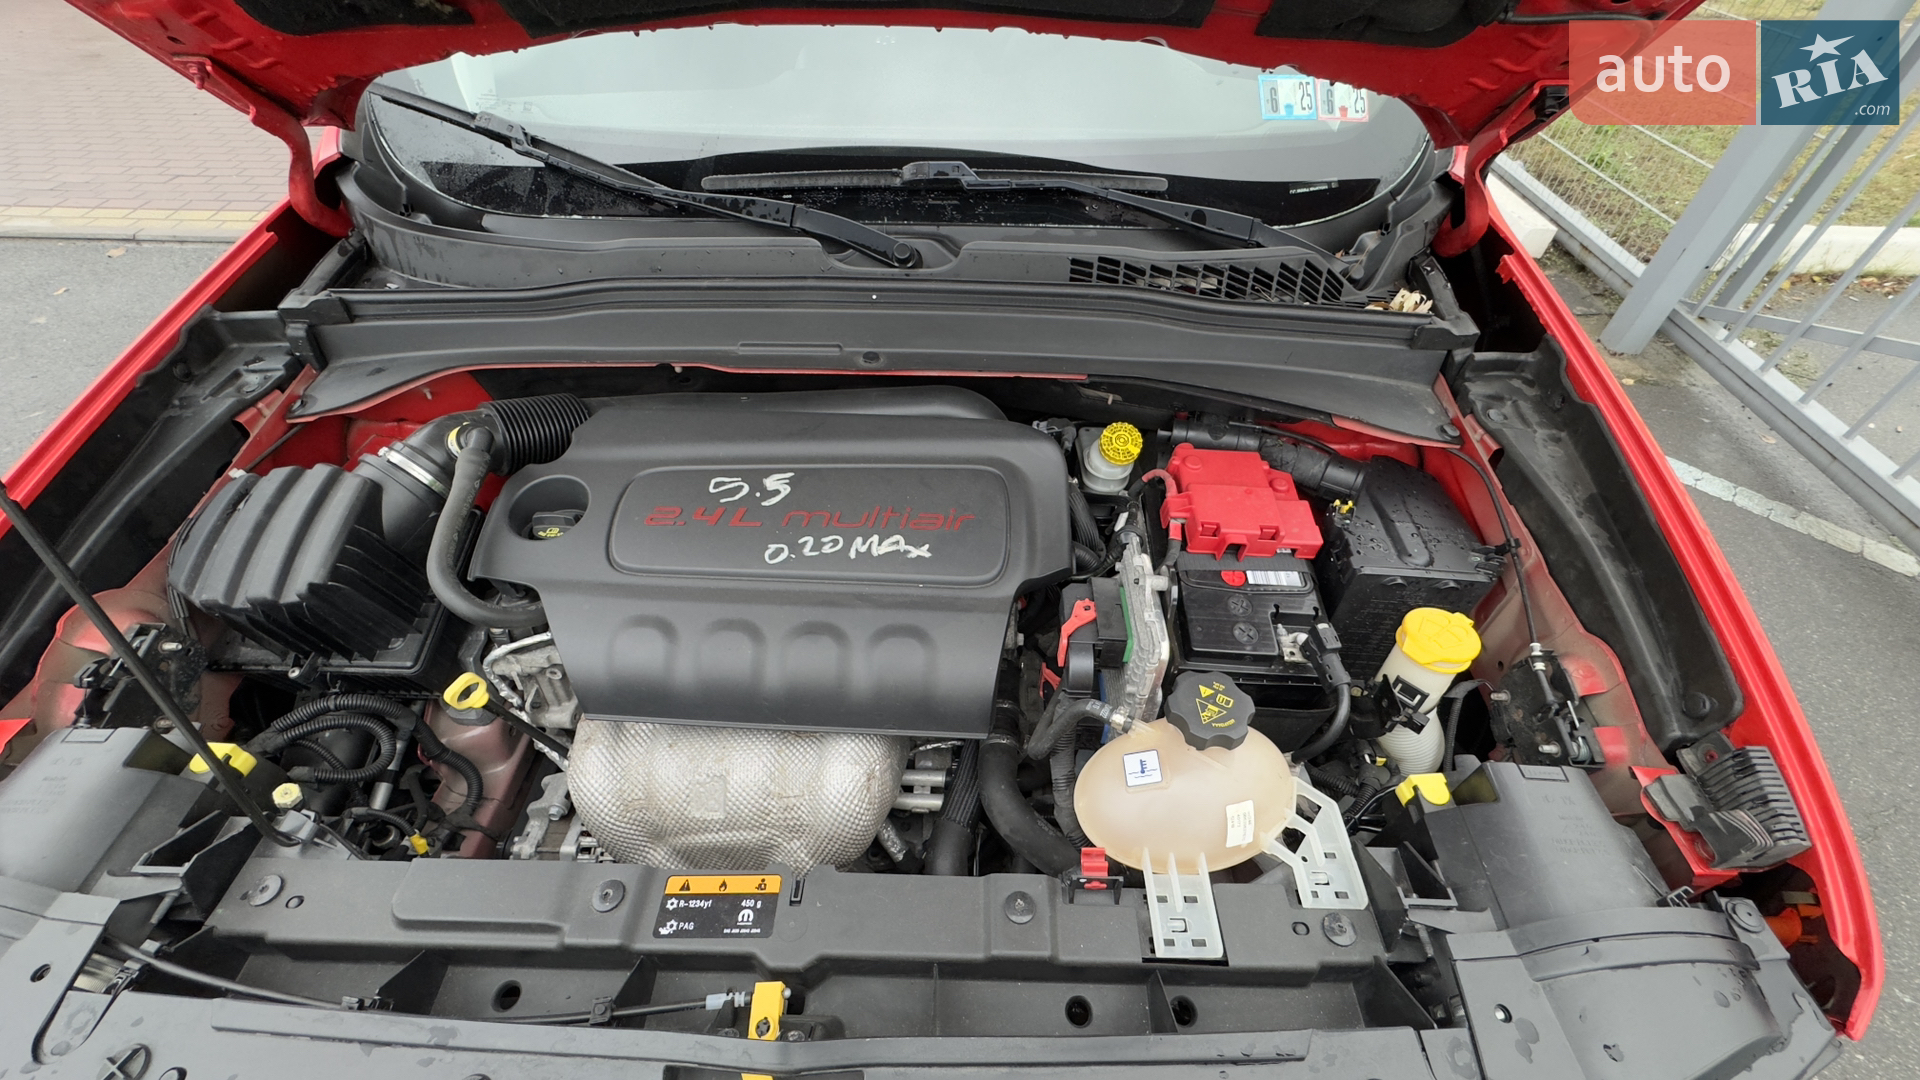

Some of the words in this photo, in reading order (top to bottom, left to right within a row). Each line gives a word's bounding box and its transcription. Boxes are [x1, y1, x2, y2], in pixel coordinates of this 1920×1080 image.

[1270, 87, 1279, 113] 6
[1298, 82, 1312, 111] 25
[1326, 89, 1334, 115] 6
[1352, 88, 1365, 114] 25
[708, 471, 795, 507] 5.5
[643, 506, 764, 528] 2.4L
[781, 504, 975, 532] multiair
[764, 535, 844, 565] 0.20
[678, 899, 713, 910] R-1234yf
[741, 899, 754, 907] 450
[678, 922, 695, 931] PAG
